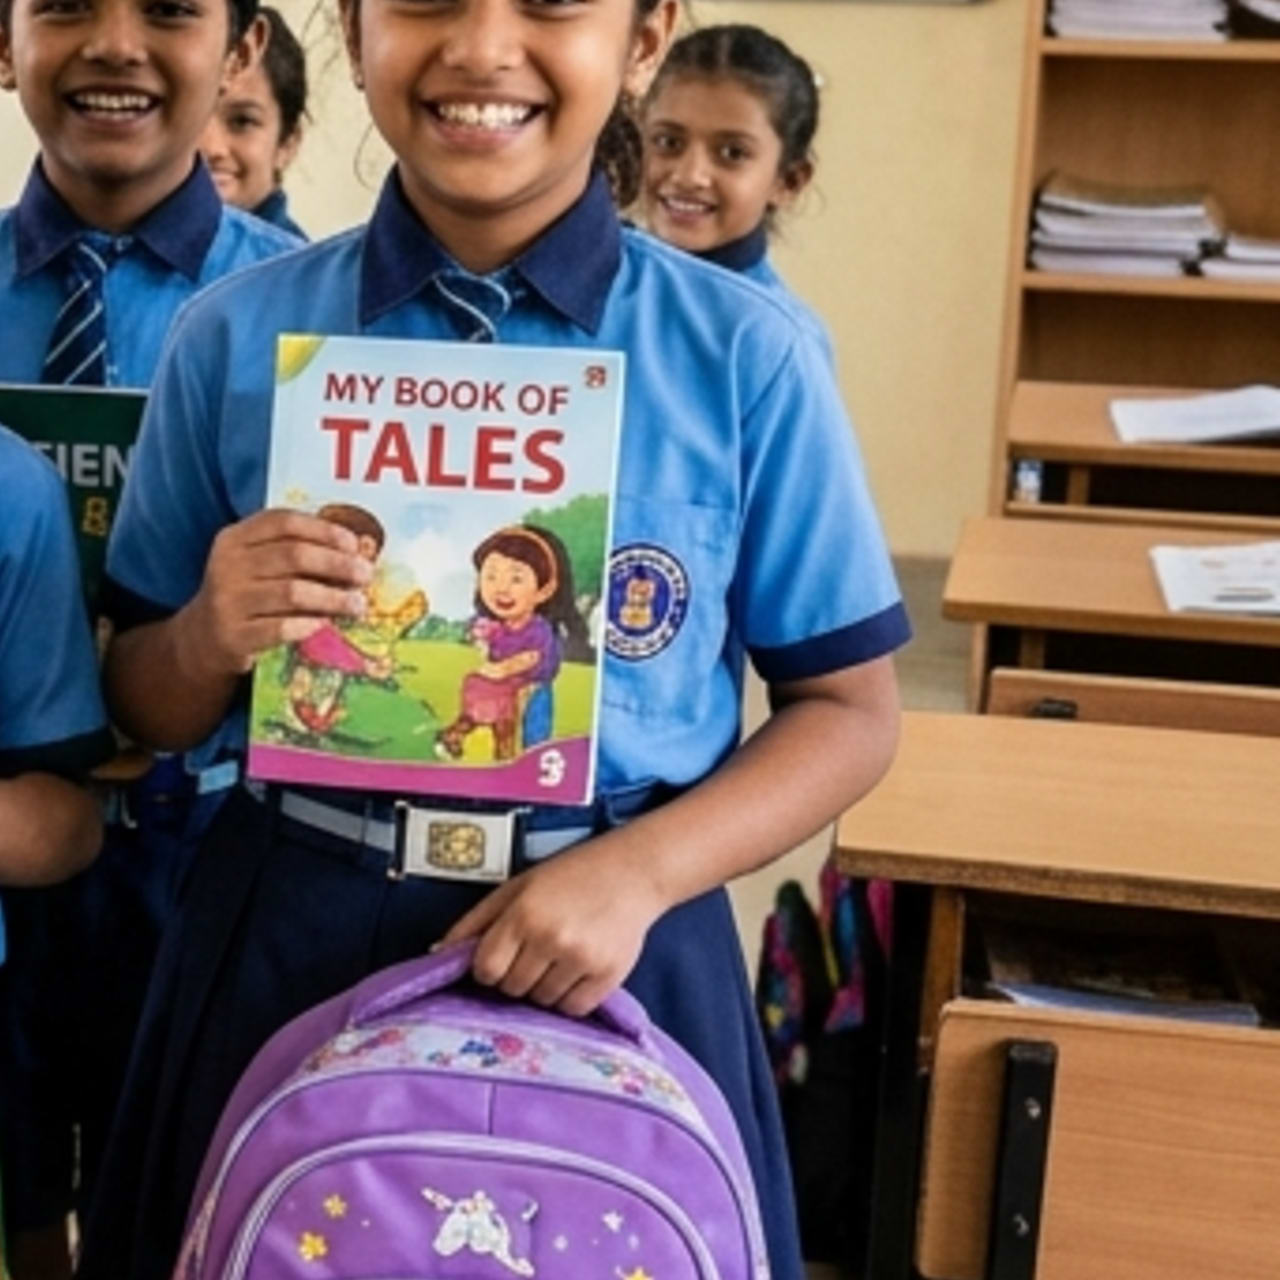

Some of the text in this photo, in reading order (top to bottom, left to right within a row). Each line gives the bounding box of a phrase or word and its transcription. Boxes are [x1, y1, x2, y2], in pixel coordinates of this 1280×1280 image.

[323, 372, 570, 417] MY BOOK OF
[320, 417, 566, 495] TALES
